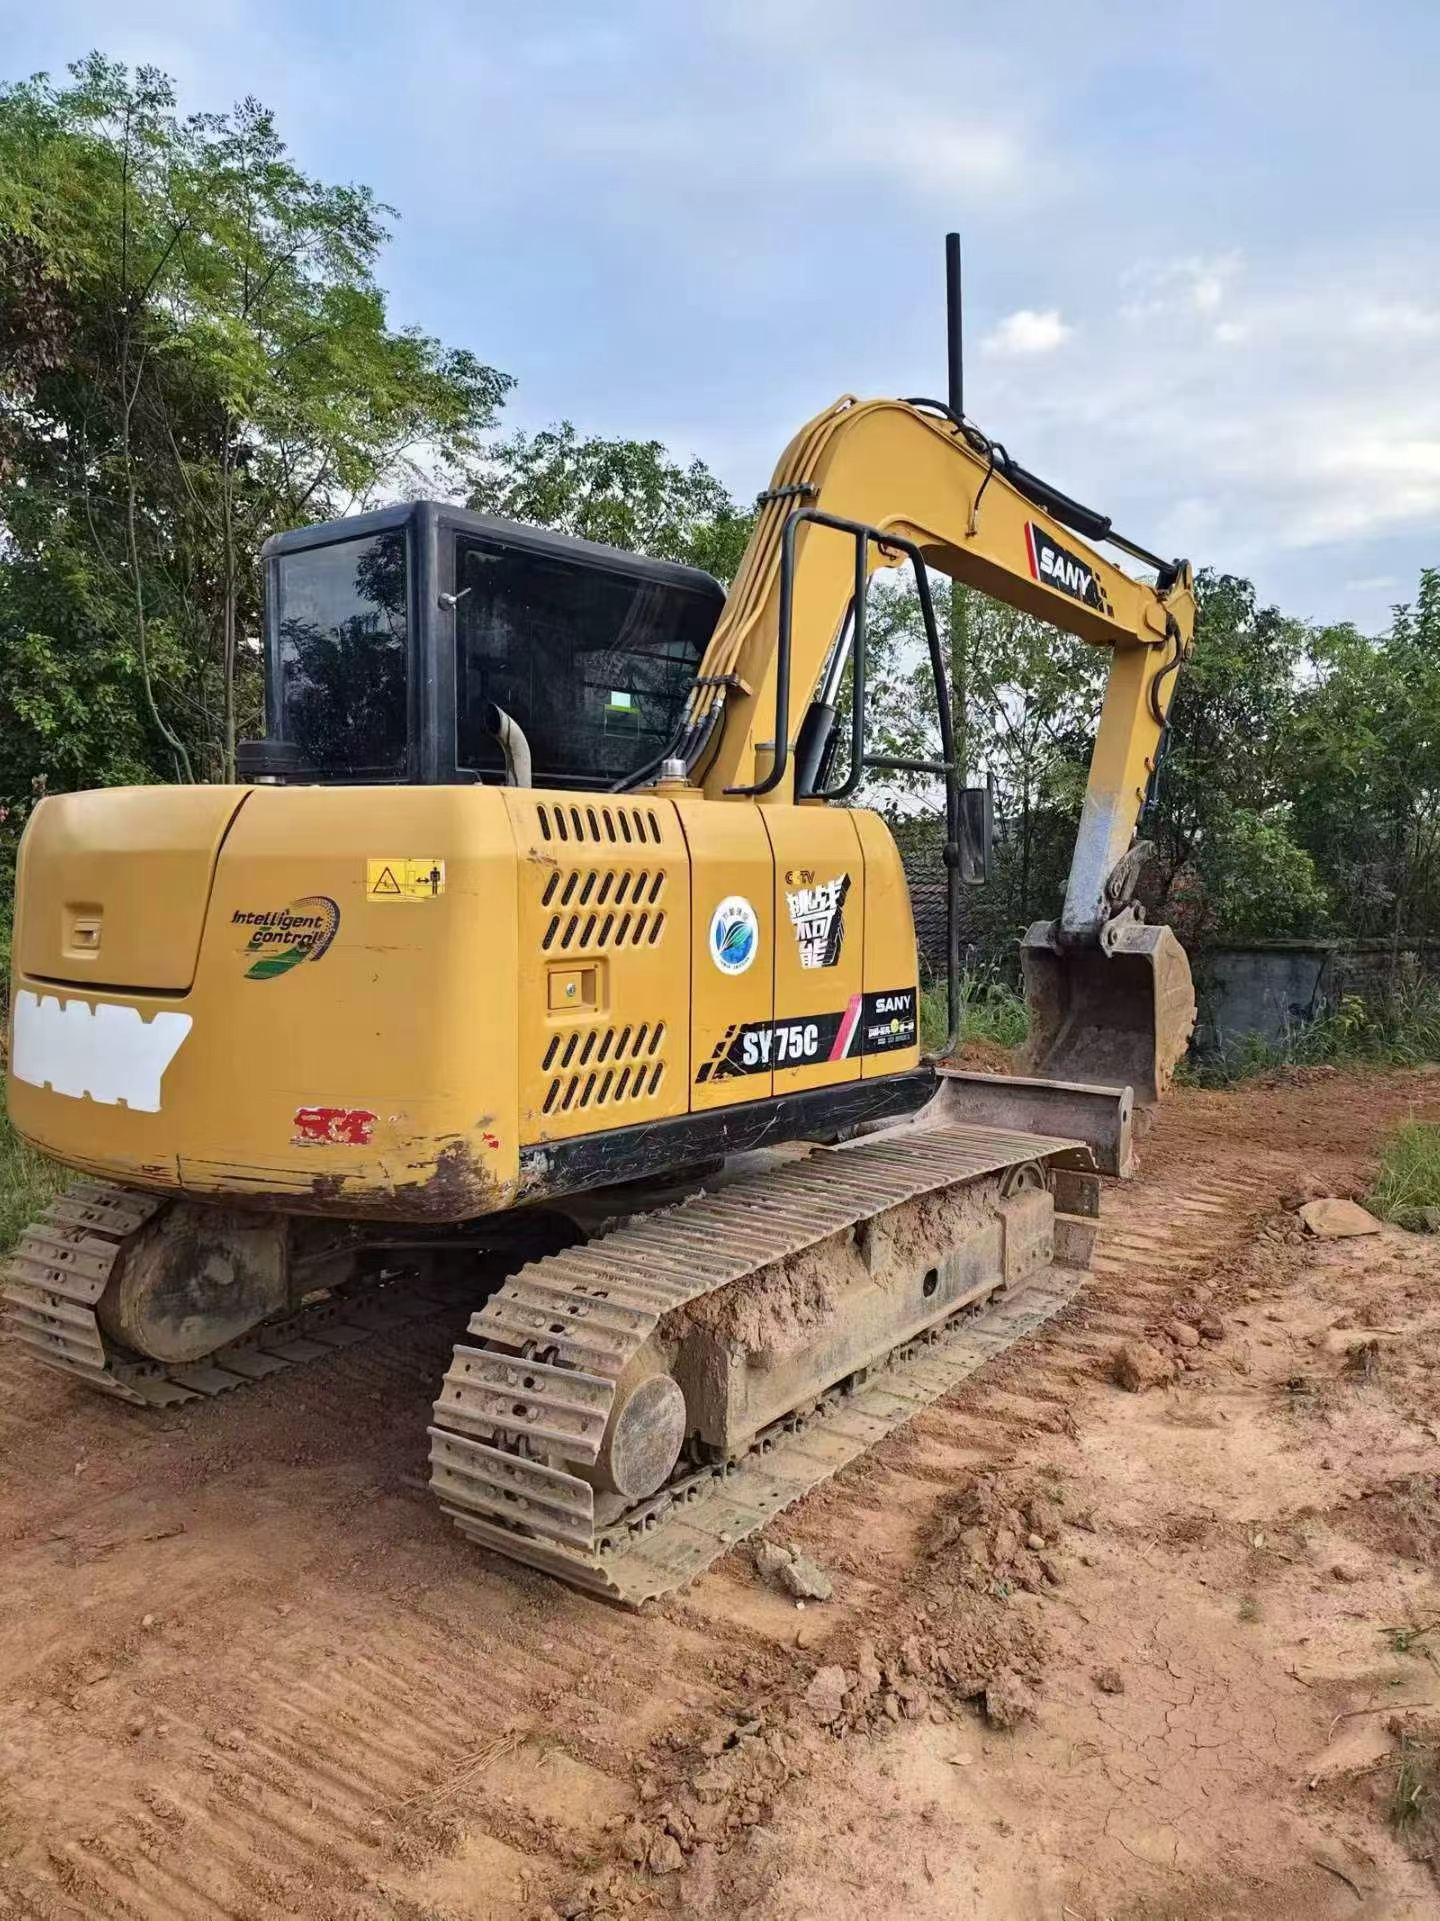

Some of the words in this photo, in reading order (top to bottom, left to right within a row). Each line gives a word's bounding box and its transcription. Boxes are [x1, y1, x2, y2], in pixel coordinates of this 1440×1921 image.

[1040, 546, 1092, 596] SANY
[785, 873, 846, 917] 挑战
[230, 909, 324, 931] Intelligent
[792, 908, 837, 941] 不可
[252, 930, 319, 946] control
[798, 938, 829, 970] 能
[875, 994, 911, 1014] SANY
